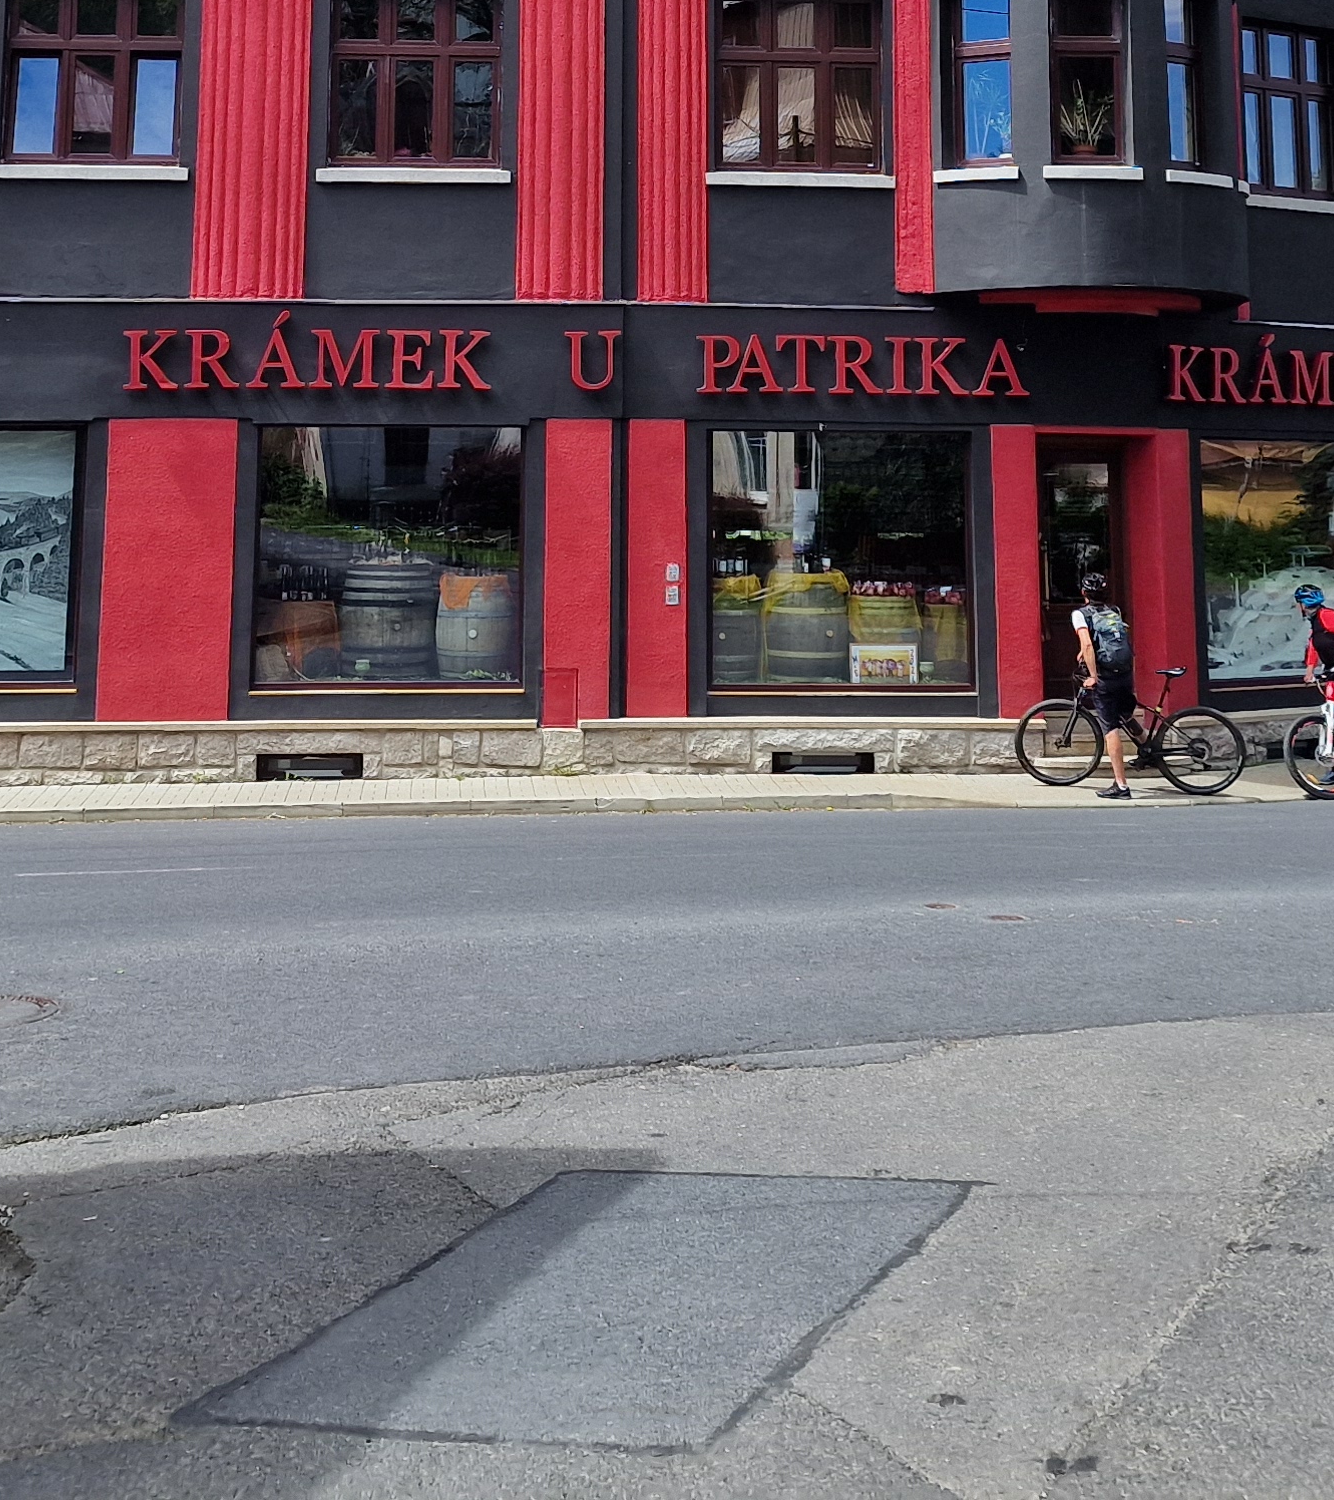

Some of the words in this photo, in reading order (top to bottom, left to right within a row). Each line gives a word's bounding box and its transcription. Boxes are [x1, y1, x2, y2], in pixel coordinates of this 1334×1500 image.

[123, 310, 491, 391] KRÁMEK
[565, 328, 623, 391] U
[696, 333, 1030, 397] PATRIKA
